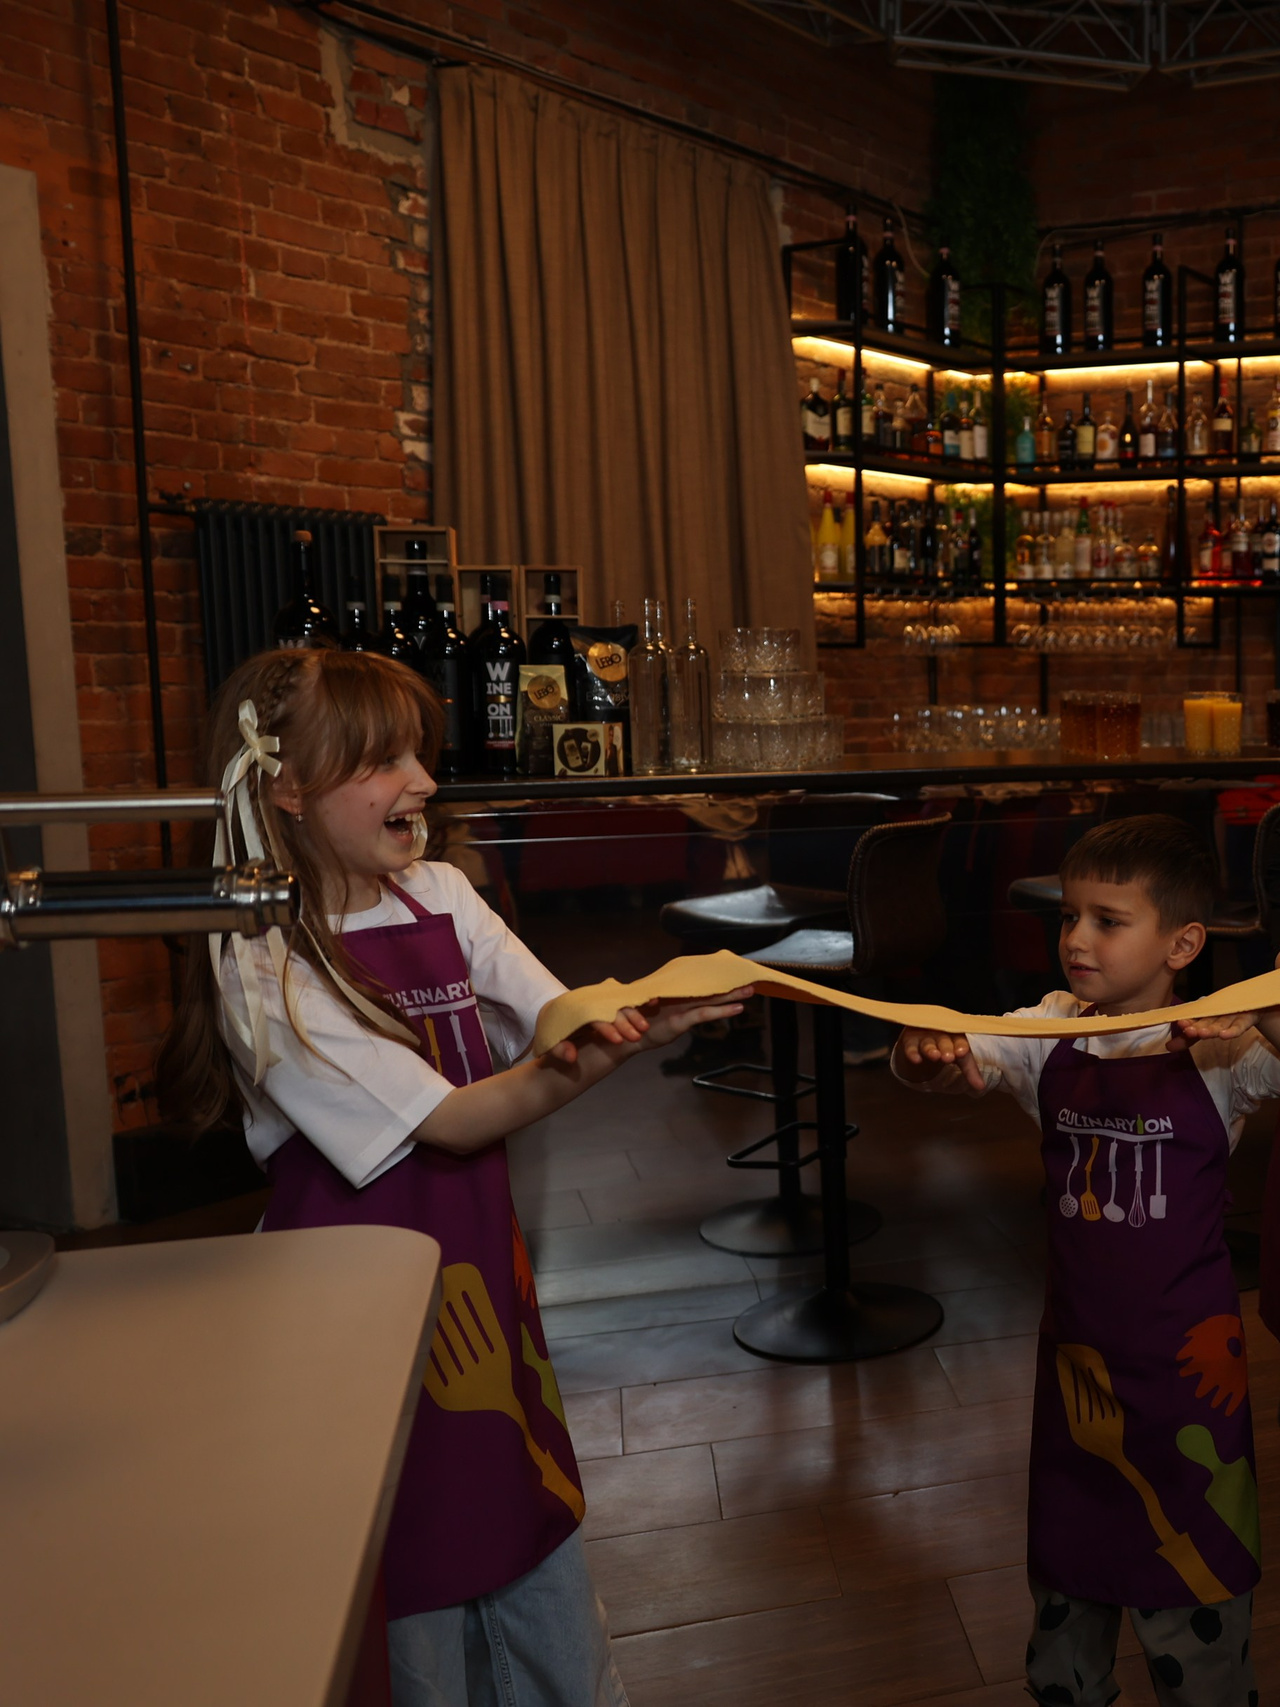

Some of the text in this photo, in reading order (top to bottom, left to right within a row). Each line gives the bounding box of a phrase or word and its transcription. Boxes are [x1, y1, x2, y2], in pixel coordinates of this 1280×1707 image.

[595, 653, 622, 669] LEBO
[486, 662, 511, 681] W
[486, 682, 512, 695] INE
[534, 684, 555, 700] LEBO
[487, 703, 511, 716] ON
